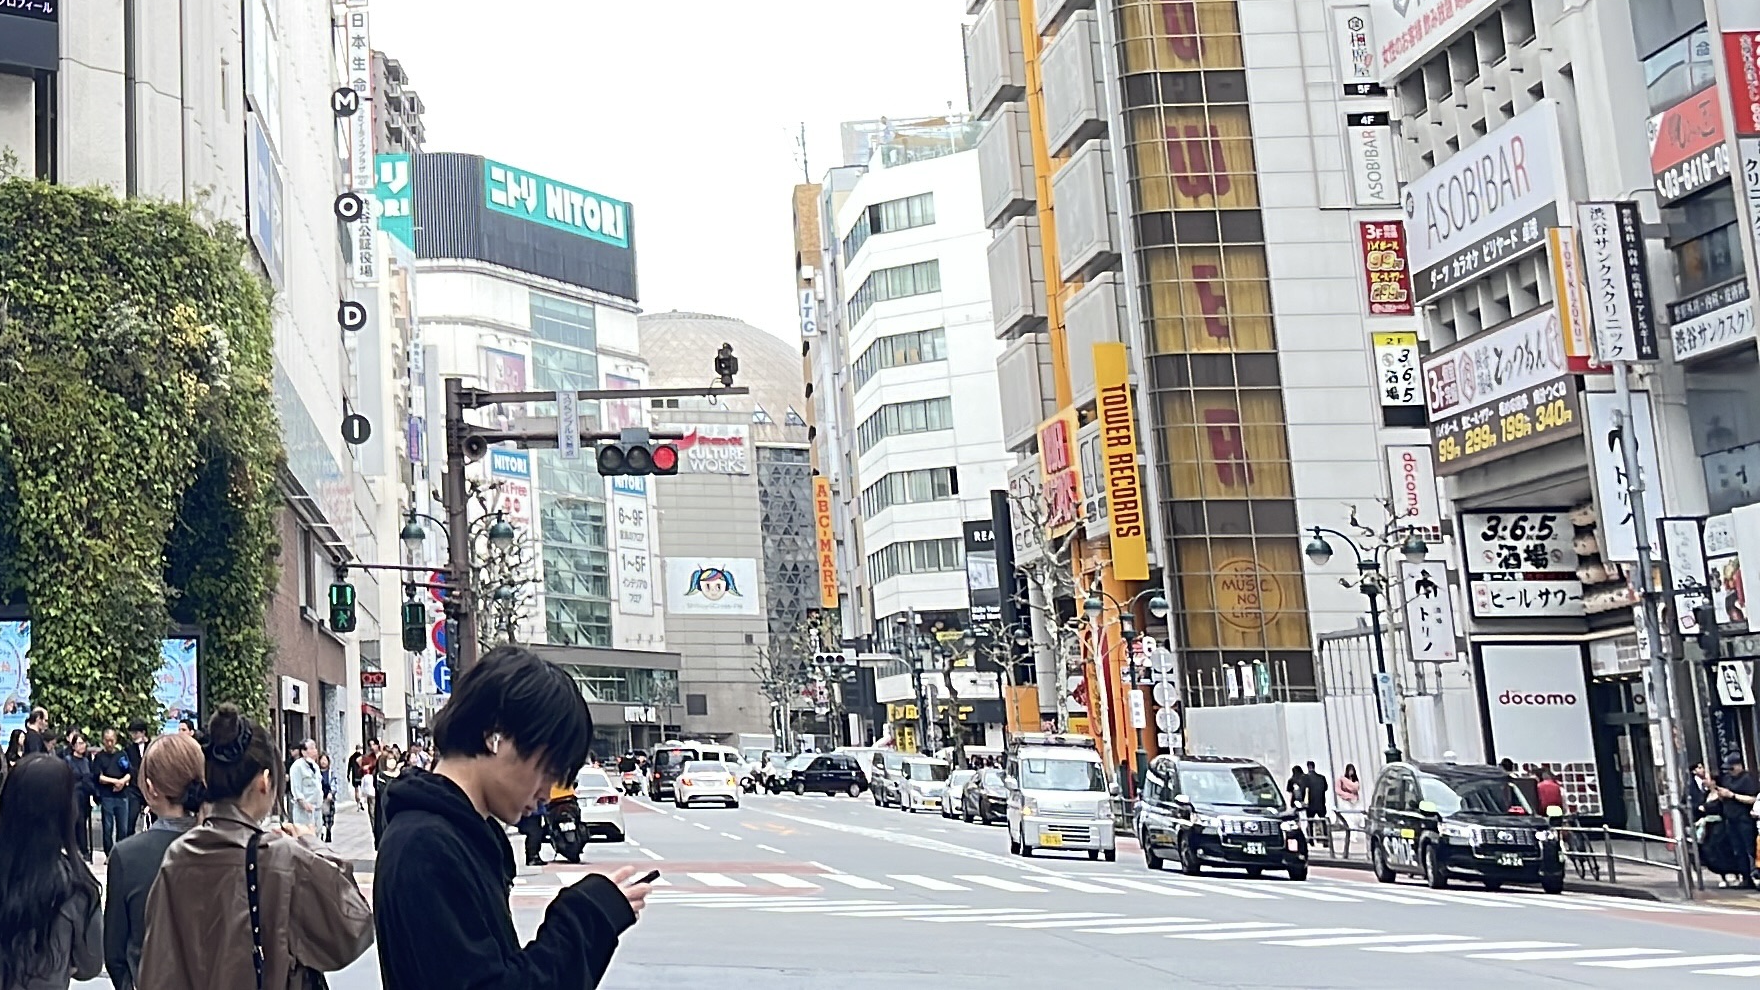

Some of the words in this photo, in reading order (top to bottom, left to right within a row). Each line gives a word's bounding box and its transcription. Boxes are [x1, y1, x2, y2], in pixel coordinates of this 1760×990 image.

[351, 13, 367, 93] 日本生命
[1357, 85, 1371, 94] 5F
[1360, 115, 1375, 125] 4F
[1366, 129, 1384, 201] ASOBIBAR
[491, 165, 538, 215] ニトリ
[545, 182, 625, 240] NITORI
[1427, 134, 1531, 250] ASOBIBAR
[1366, 224, 1383, 239] 3F
[1452, 249, 1480, 278] カラオケ
[1589, 207, 1624, 358] 渋谷サンクスクリニック
[803, 291, 816, 333] ITC
[1101, 382, 1131, 448] TOWER
[493, 454, 528, 475] NITORI
[689, 445, 745, 461] CULTURE
[690, 459, 747, 473] WORKS
[1108, 453, 1141, 538] RECORDS
[1402, 452, 1420, 518] docomo
[1496, 543, 1549, 570] 酒場
[1237, 593, 1257, 605] NO
[1498, 688, 1577, 706] docomo
